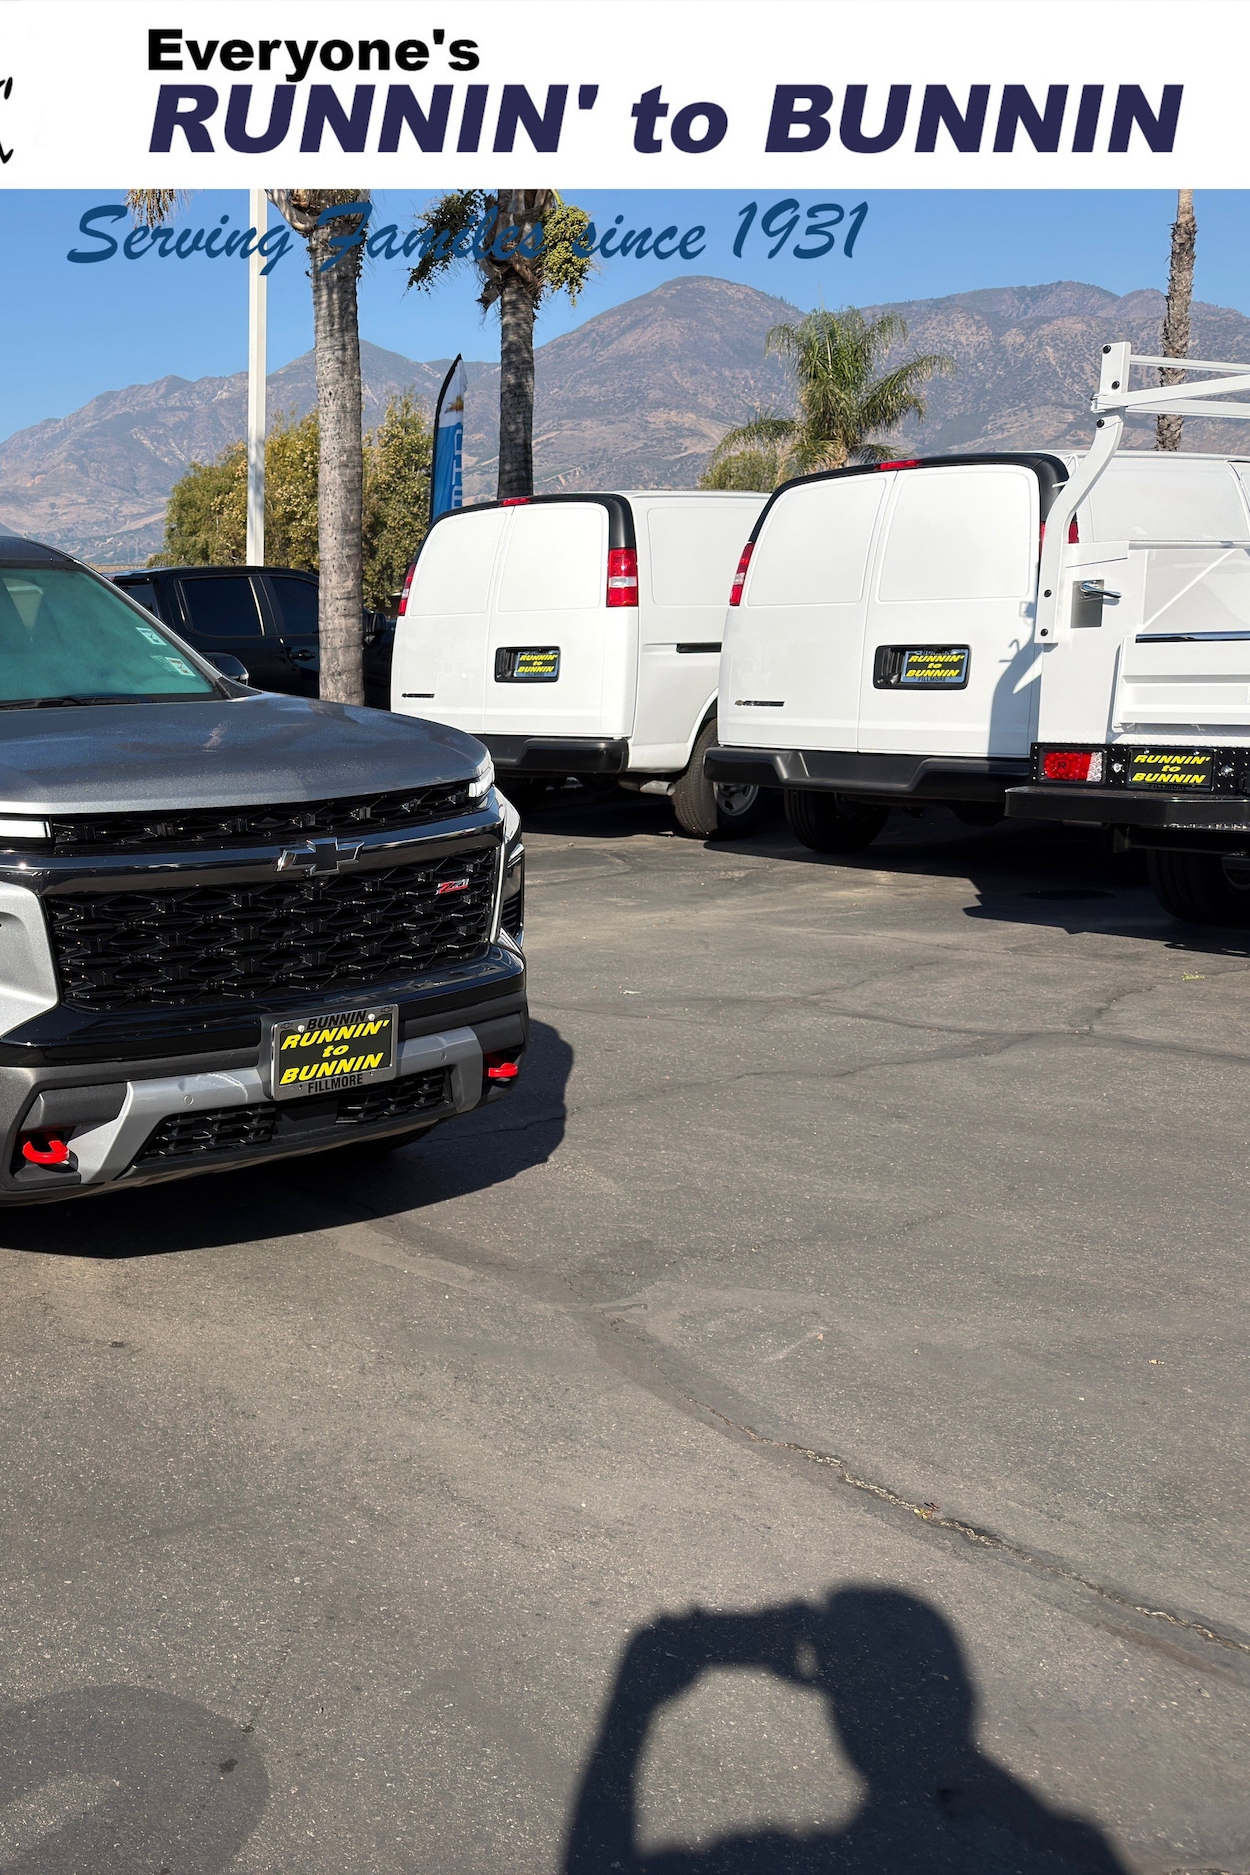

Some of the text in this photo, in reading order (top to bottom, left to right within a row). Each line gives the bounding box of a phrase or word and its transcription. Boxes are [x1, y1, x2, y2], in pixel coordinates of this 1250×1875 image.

[907, 655, 965, 663] RUNNIN'
[906, 669, 960, 677] BUNNIN
[1133, 754, 1211, 765] RUNNIN'
[1161, 764, 1182, 772] to
[1132, 772, 1206, 784] BUNNIN
[306, 1010, 368, 1031] BUNNIN
[280, 1019, 390, 1050] RUNNIN'
[322, 1045, 349, 1058] to
[279, 1052, 384, 1085] BUNNIN
[307, 1073, 363, 1093] FILLMORE
